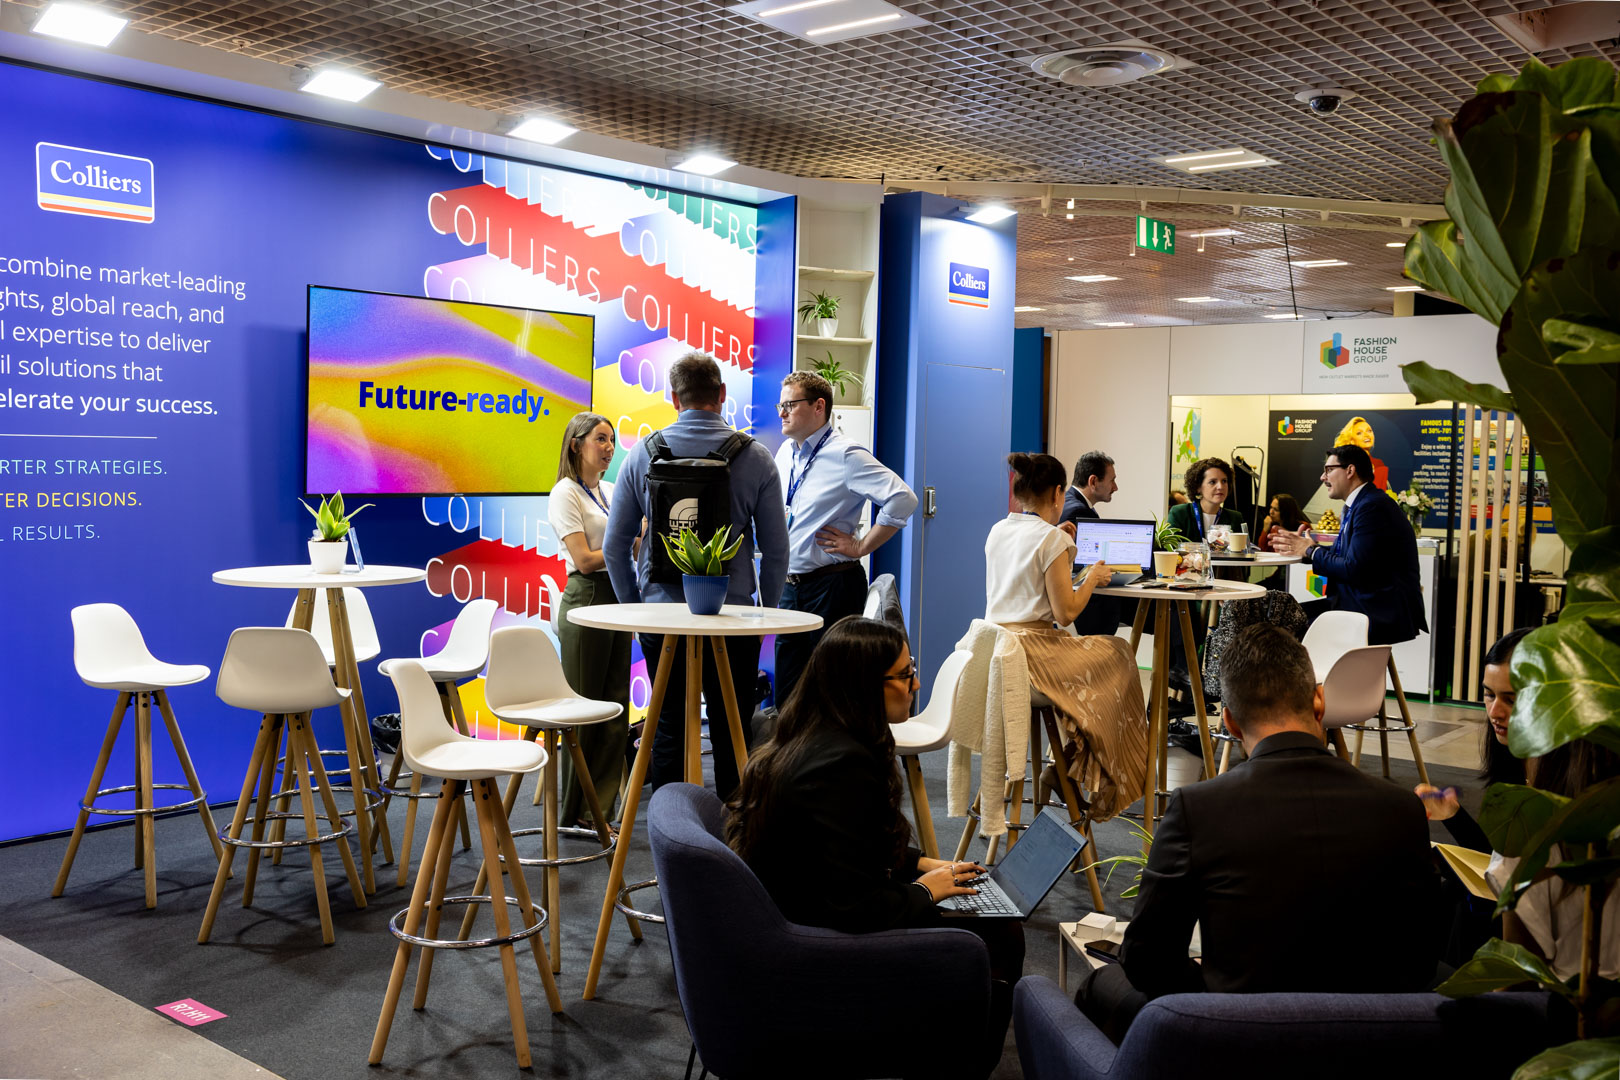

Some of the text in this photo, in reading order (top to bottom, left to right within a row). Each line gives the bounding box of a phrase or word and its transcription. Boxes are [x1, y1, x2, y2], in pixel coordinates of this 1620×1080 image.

[50, 159, 142, 194] Colliers
[428, 192, 601, 304] COLLIERS
[99, 267, 246, 300] market-leading
[952, 271, 987, 291] Colliers
[51, 291, 115, 316] global
[122, 301, 183, 323] reach,
[189, 306, 224, 324] and
[12, 326, 113, 348] expertise
[119, 331, 140, 349] to
[146, 333, 211, 353] deliver
[1353, 337, 1397, 346] FASHION
[1353, 346, 1388, 355] HOUSE
[1353, 355, 1388, 363] GROUP
[18, 356, 117, 380] solutions
[122, 362, 163, 382] that
[80, 395, 130, 416] your
[136, 398, 218, 415] success.
[359, 381, 550, 423] Future-ready.
[54, 460, 167, 474] STRATEGIES.
[36, 491, 142, 507] DECISIONS.
[12, 525, 101, 541] RESULTS.
[170, 1003, 212, 1021] R7.H11
